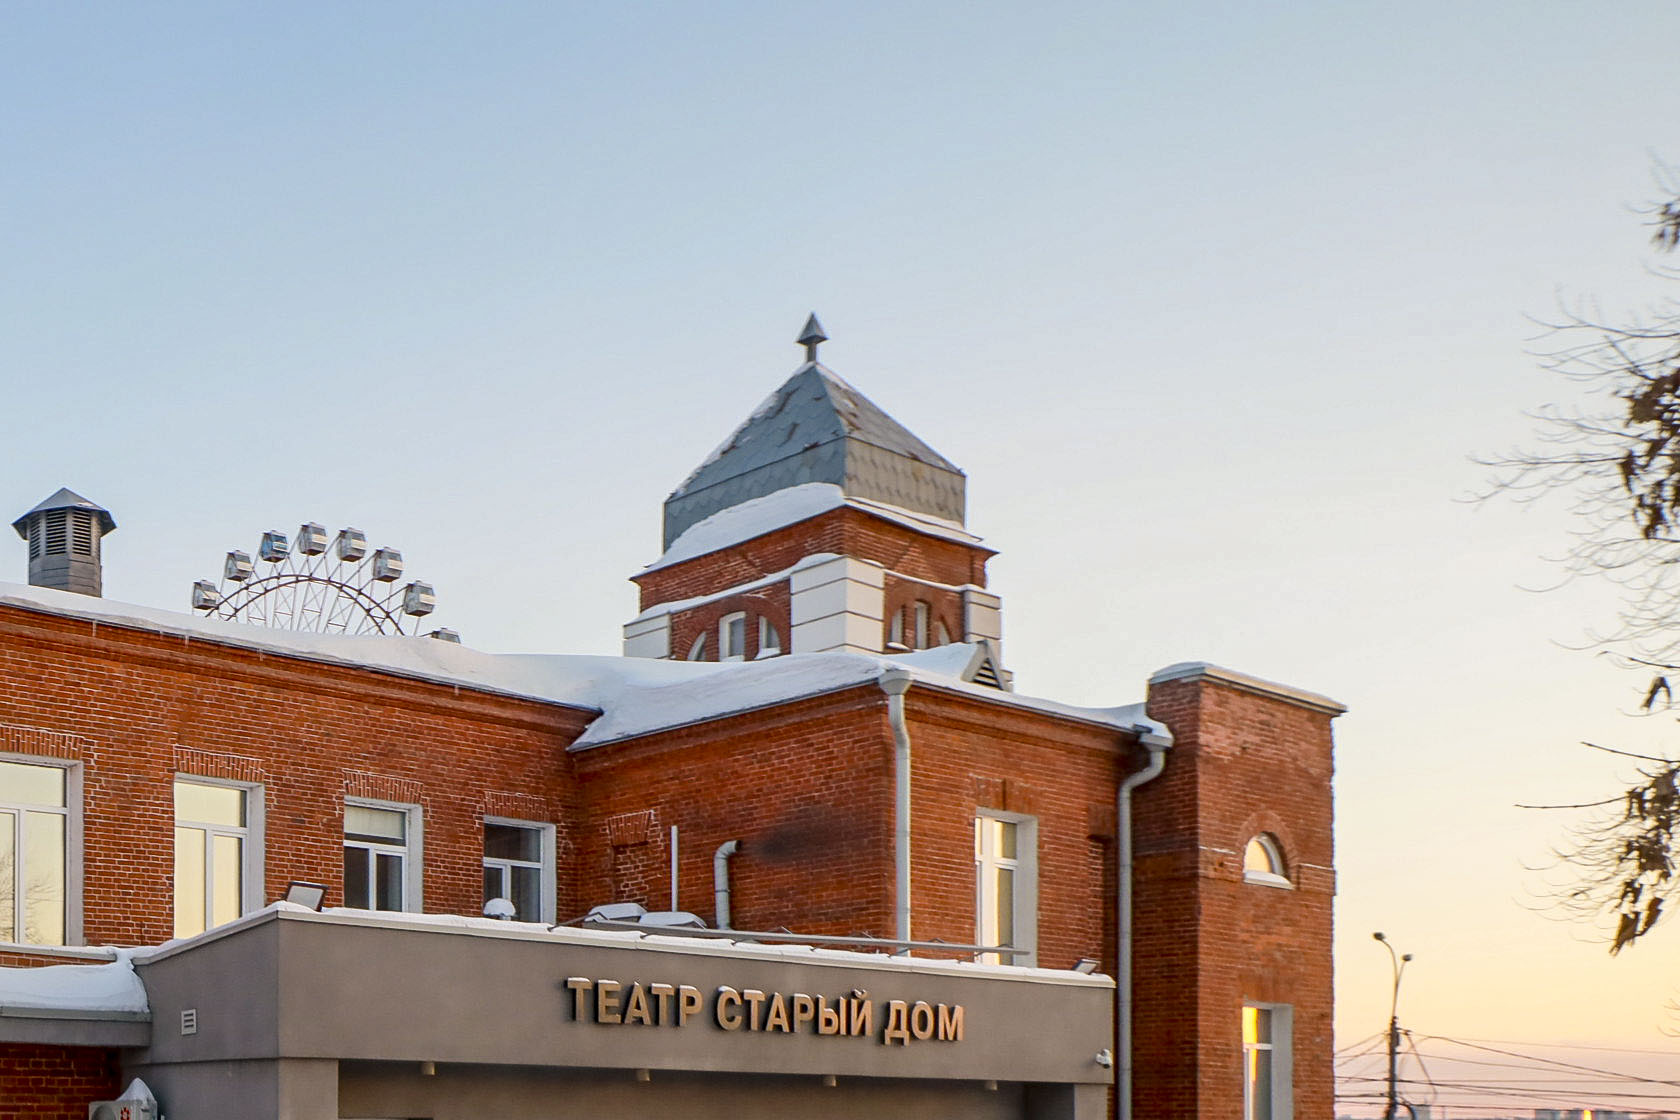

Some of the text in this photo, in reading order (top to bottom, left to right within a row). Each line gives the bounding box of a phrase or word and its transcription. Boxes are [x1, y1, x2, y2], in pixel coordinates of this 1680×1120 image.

[567, 976, 965, 1046] ТЕАТР СТАРЫЙ ДОМ
